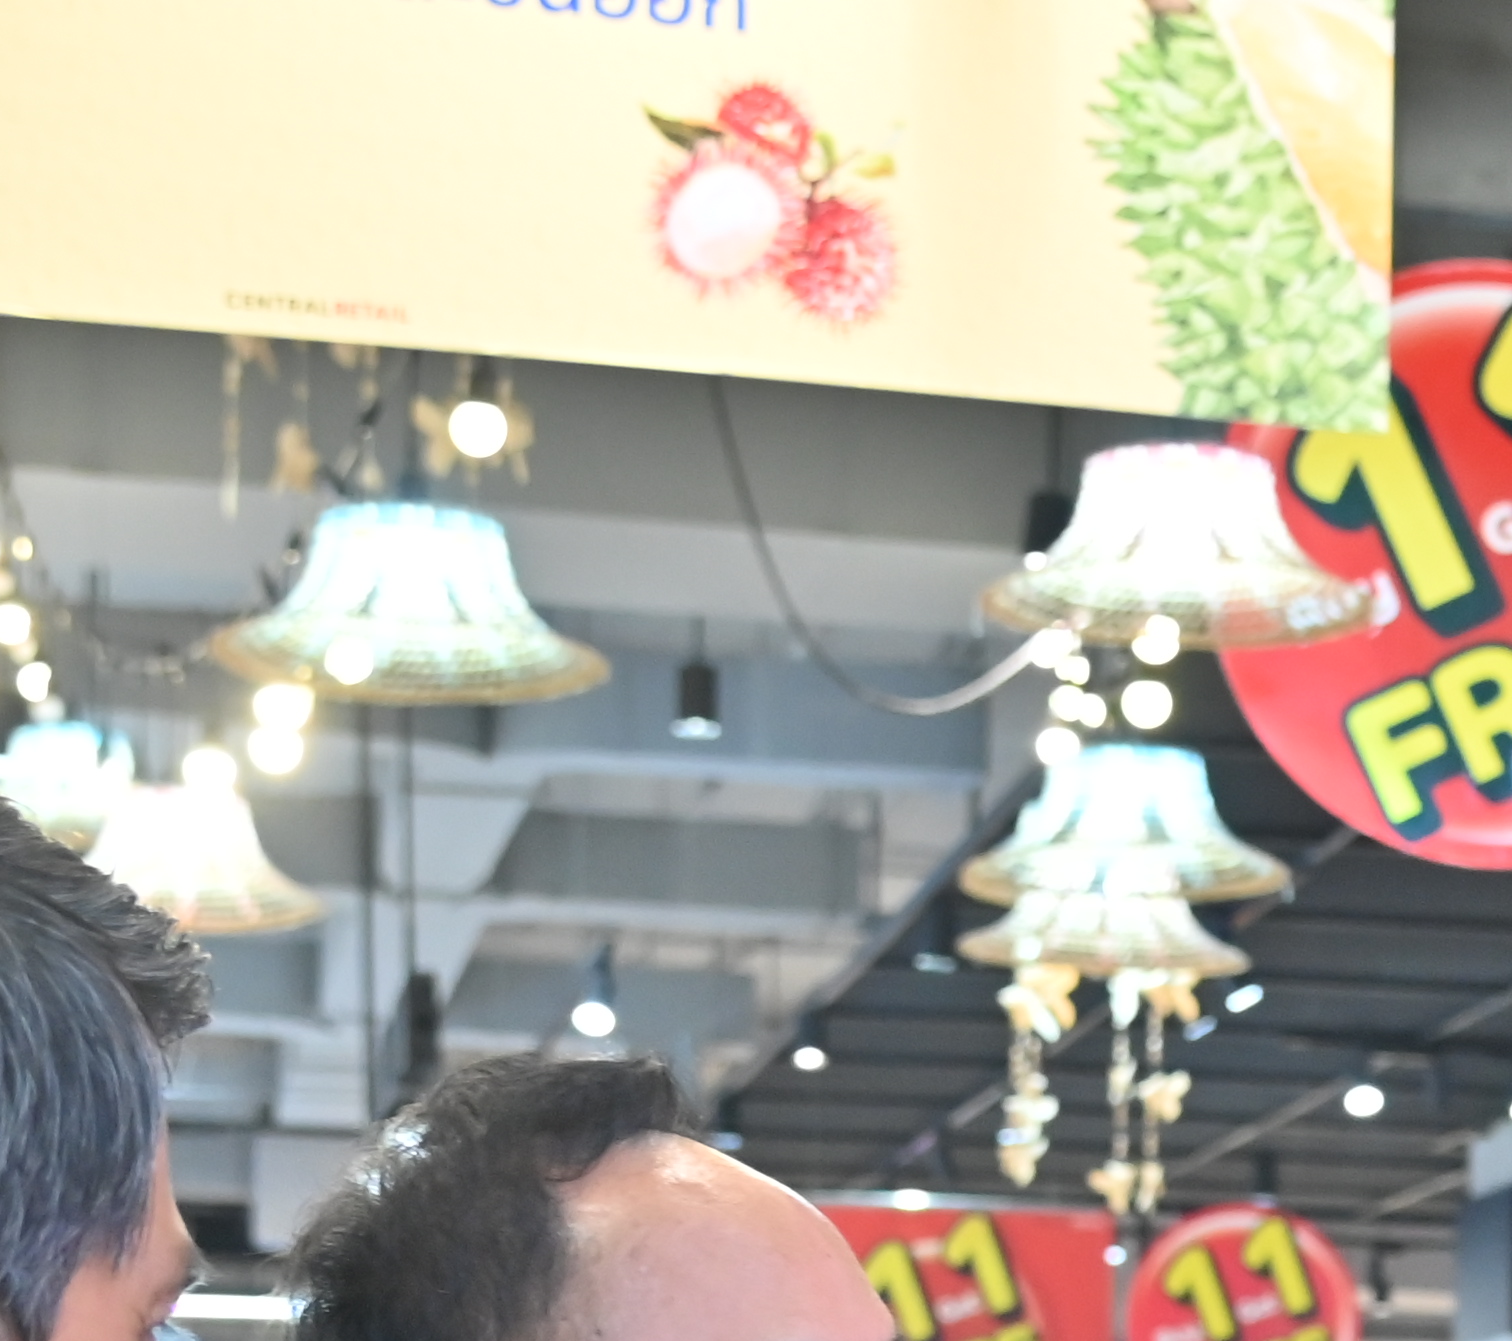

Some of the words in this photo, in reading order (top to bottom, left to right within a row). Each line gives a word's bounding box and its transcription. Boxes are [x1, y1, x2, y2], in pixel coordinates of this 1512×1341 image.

[1290, 395, 1478, 616] 1
[944, 1212, 1019, 1316] 1
[1242, 1215, 1315, 1315] 1
